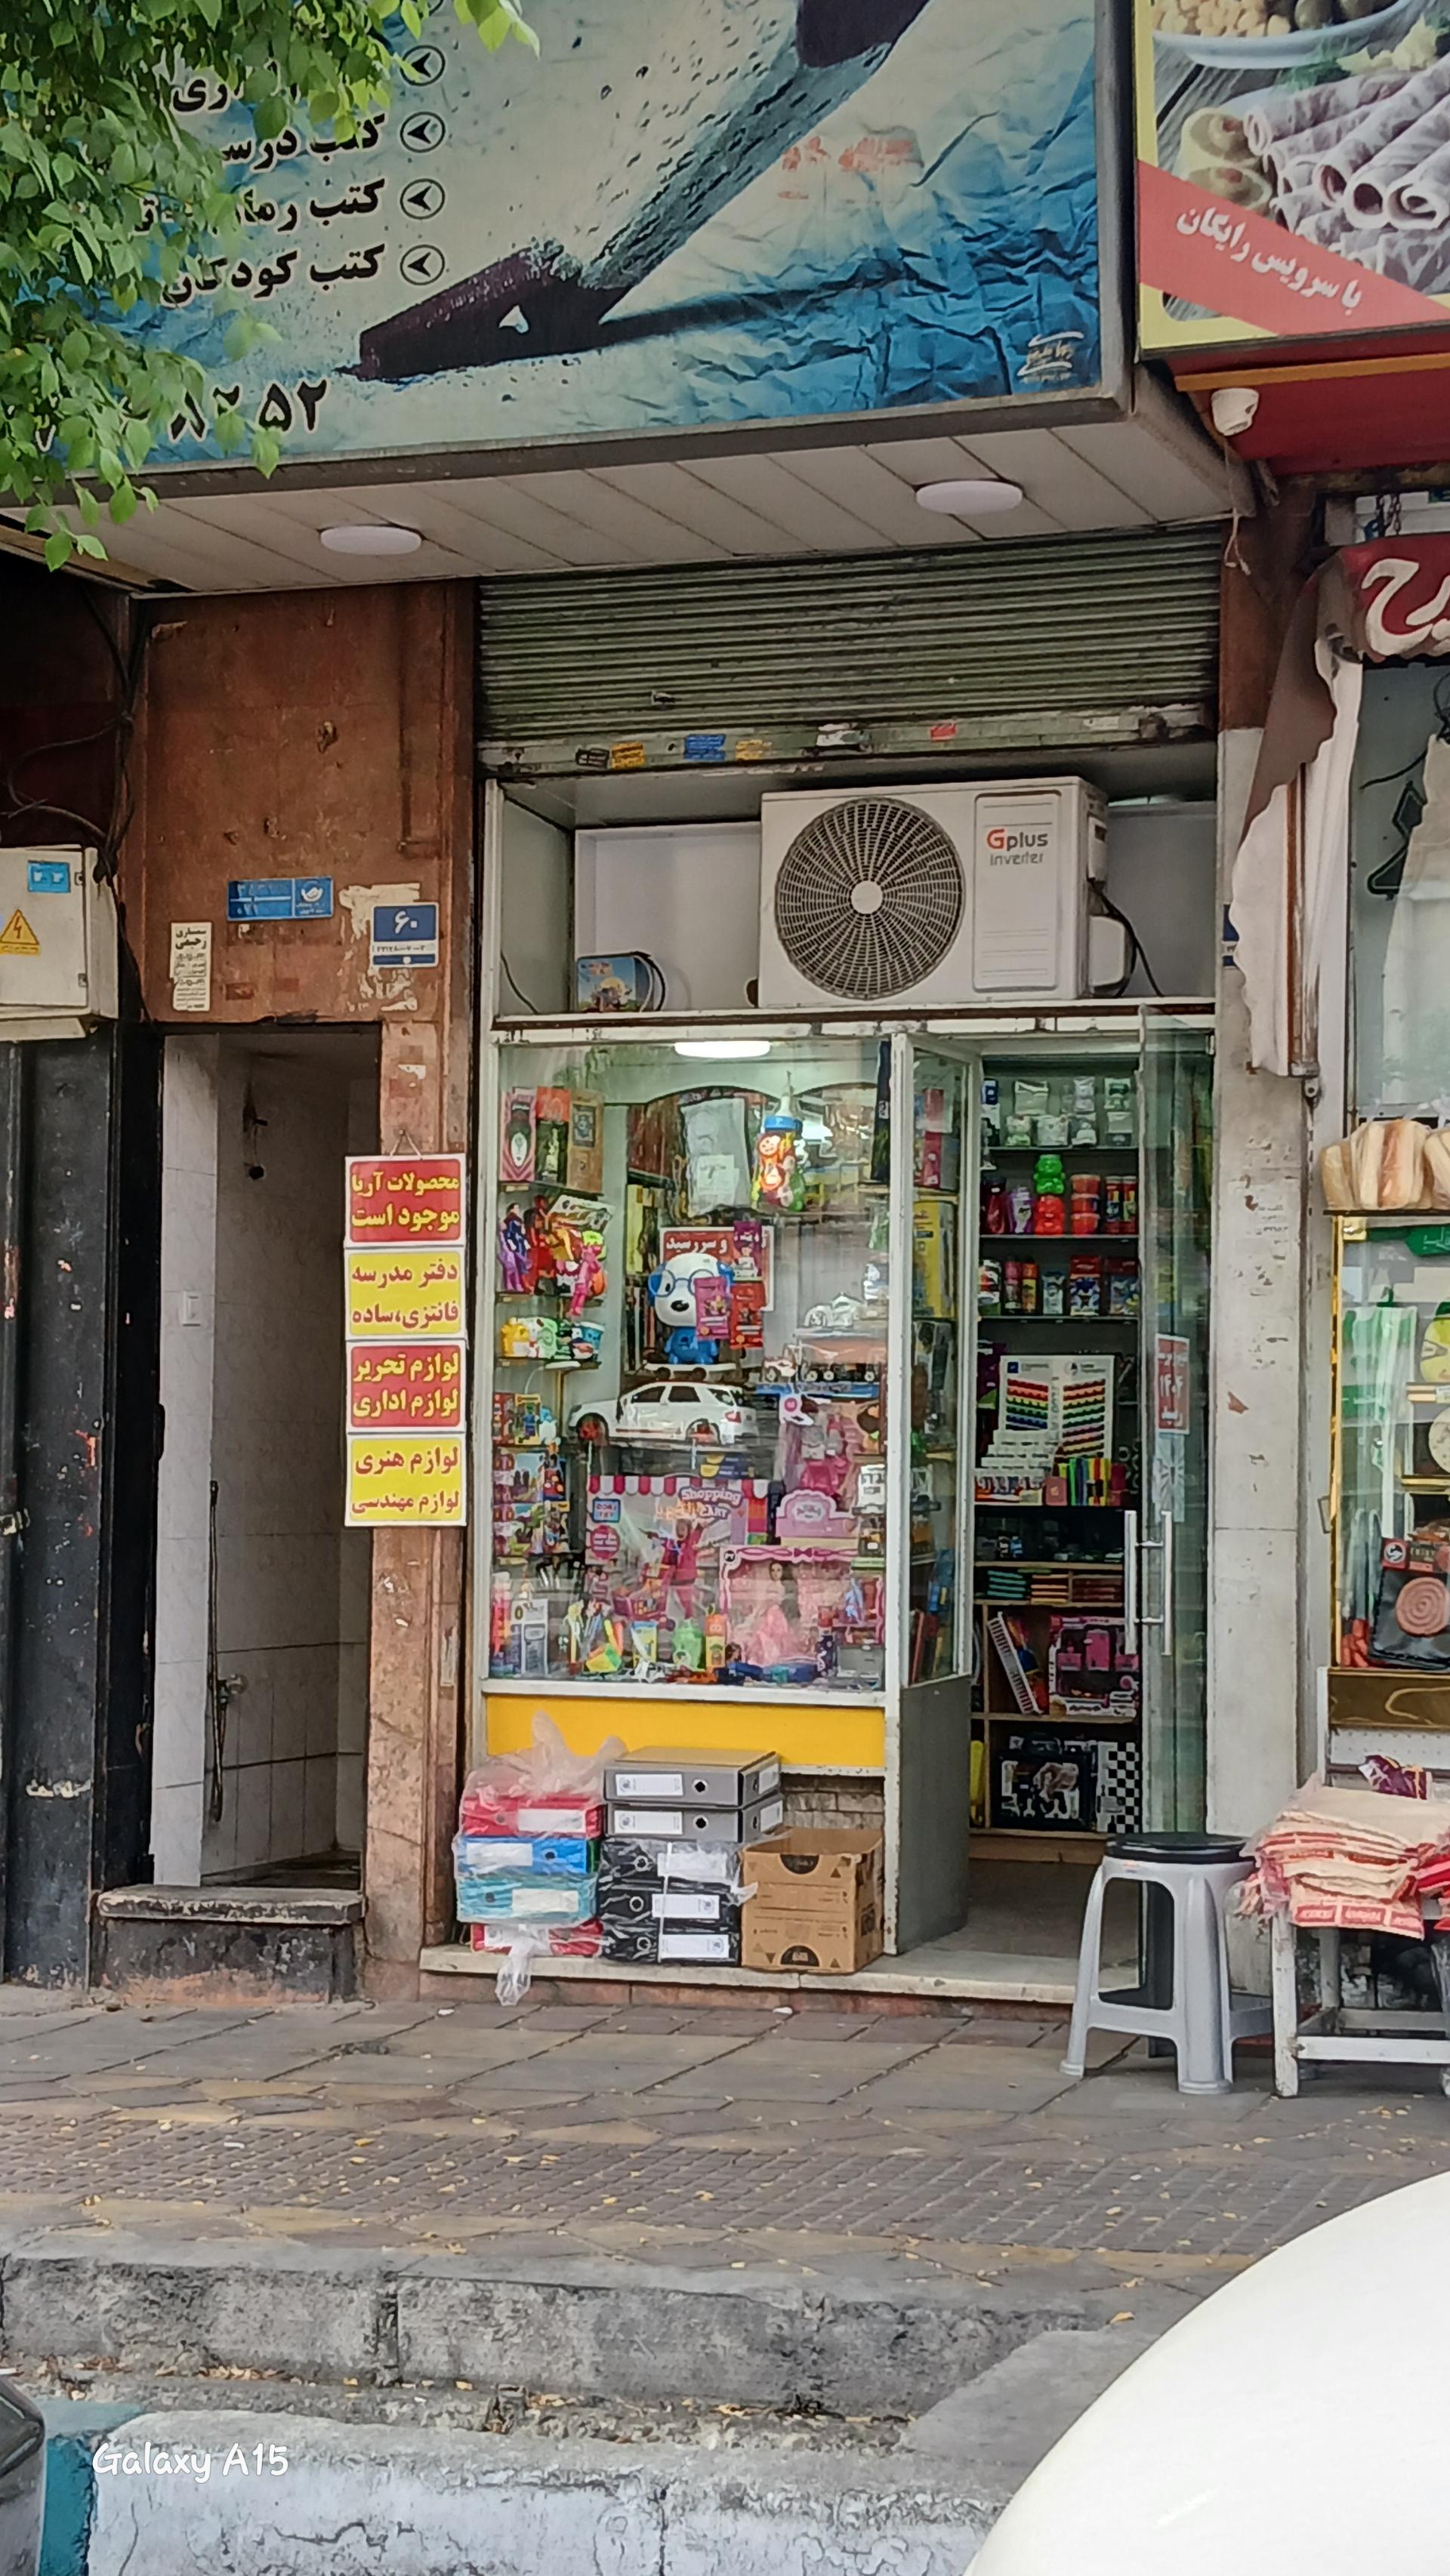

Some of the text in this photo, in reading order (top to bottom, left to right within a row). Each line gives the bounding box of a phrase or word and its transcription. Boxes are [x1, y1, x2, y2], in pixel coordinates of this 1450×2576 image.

[223, 128, 297, 170] درس
[236, 189, 298, 232] رما
[310, 178, 384, 226] کتب
[310, 243, 384, 290] کتب
[1176, 207, 1362, 316] با سرویس رایگان
[986, 828, 1048, 852] Gplus
[395, 911, 418, 934] ۶۰
[351, 1171, 460, 1197] محصولات آریا
[351, 1203, 460, 1232] موجود است
[352, 1258, 458, 1289] دفتر مدرسه
[353, 1352, 458, 1382] لوازم تحریر
[353, 1388, 458, 1418] لوازم اداری
[355, 1447, 458, 1474] لوازم هنری
[351, 1490, 459, 1514] لوازم مهندسی
[681, 1487, 742, 1506] Shopping
